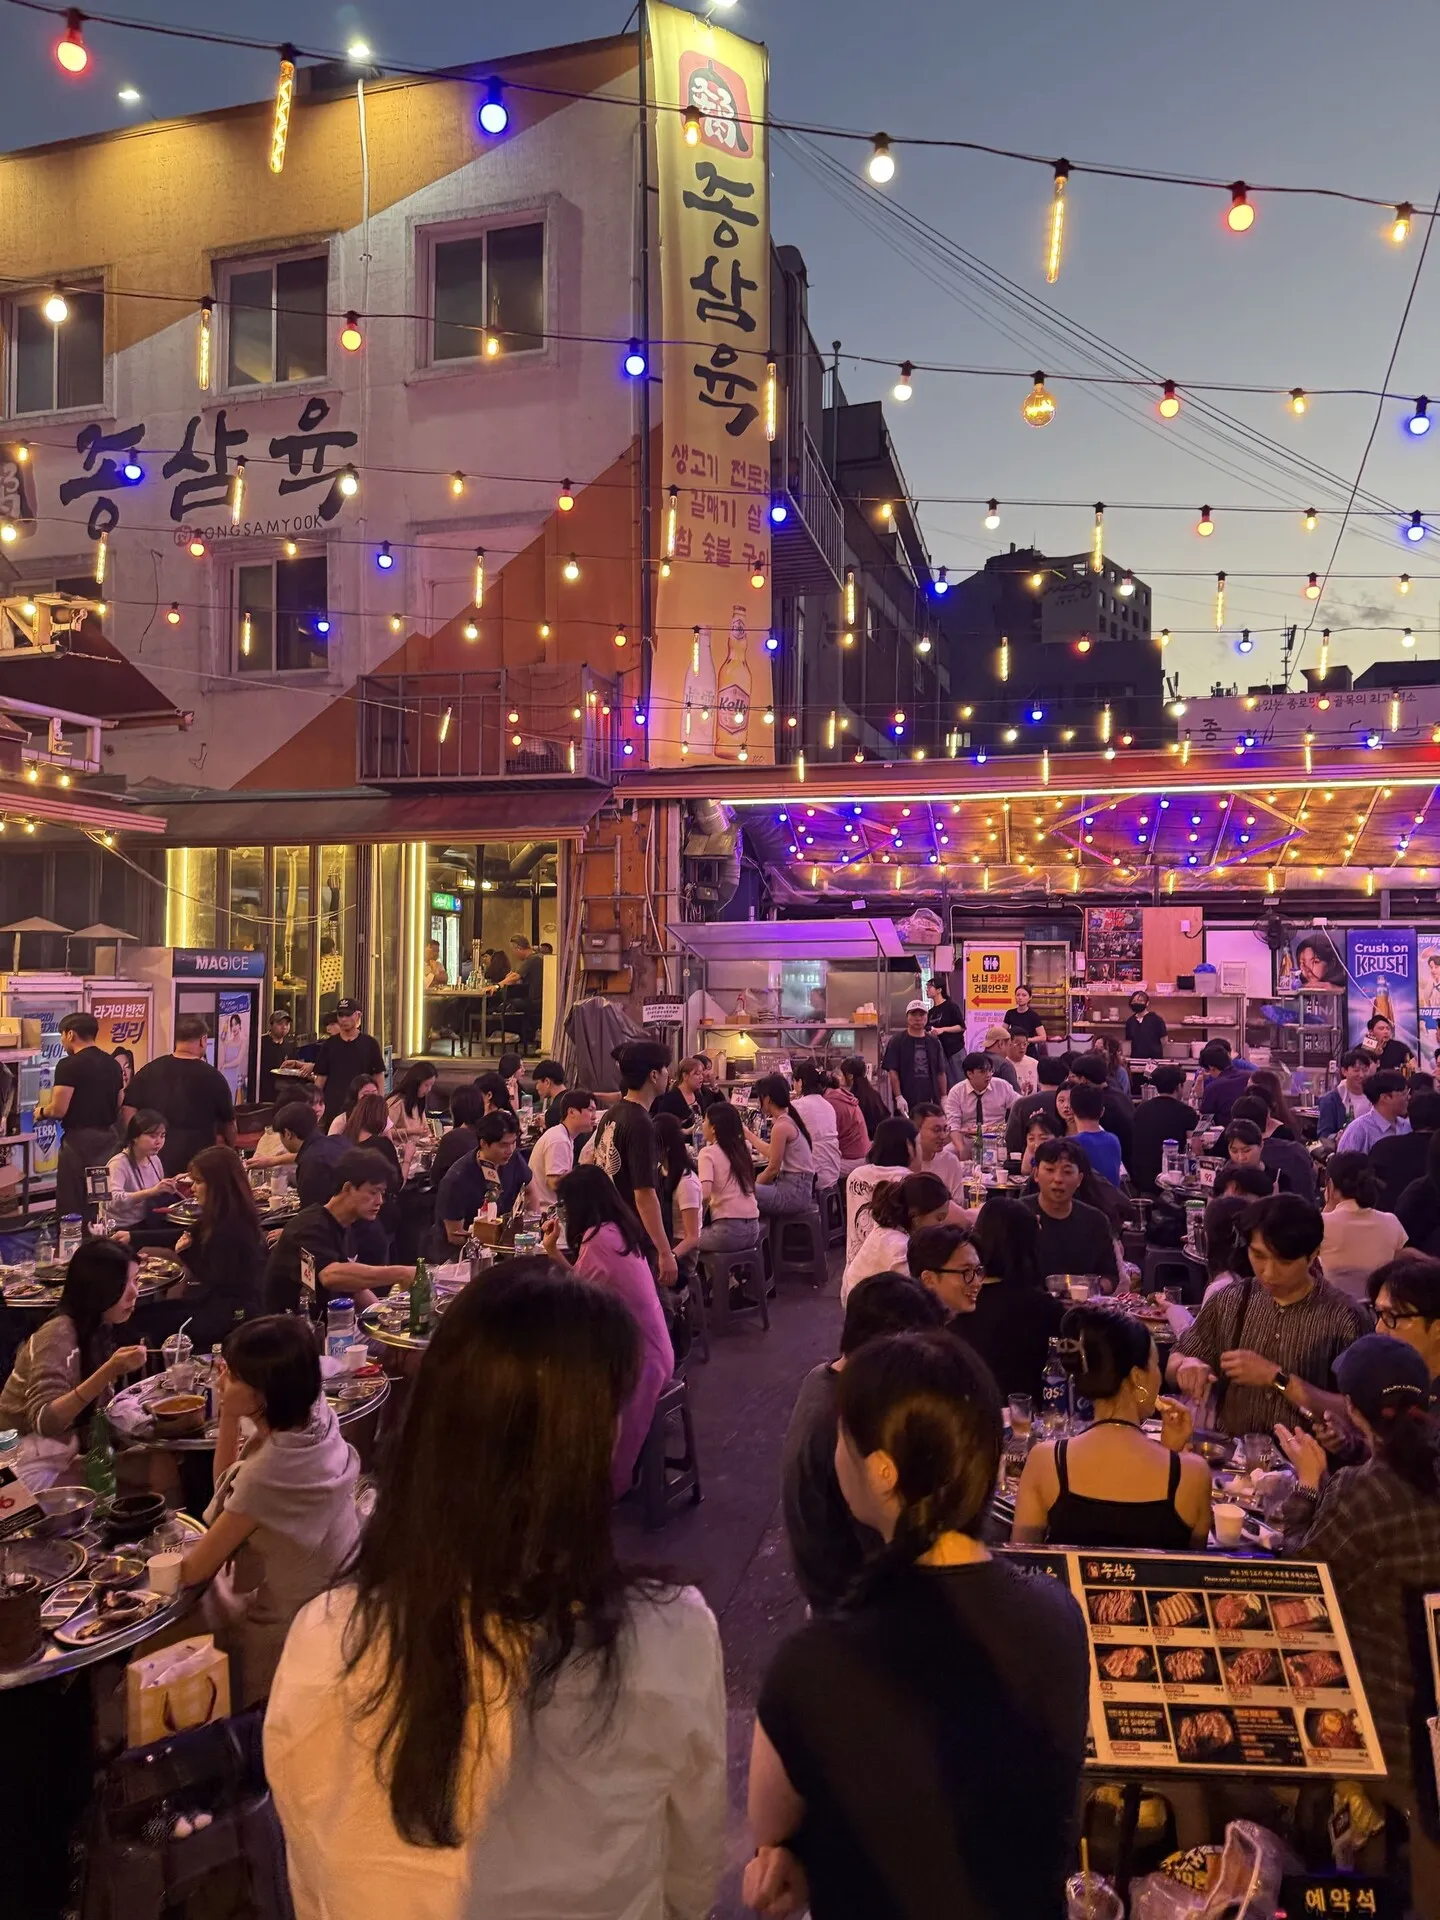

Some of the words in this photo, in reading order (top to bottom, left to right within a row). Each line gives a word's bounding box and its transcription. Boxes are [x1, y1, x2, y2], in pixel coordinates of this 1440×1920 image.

[683, 161, 759, 437] 종삼육
[60, 400, 362, 541] 종삼육
[672, 444, 718, 485] 생고기
[691, 489, 736, 528] 갈매기
[748, 504, 762, 534] 살
[203, 514, 324, 540] ONGSAMYOOK
[702, 532, 732, 567] 숯불
[719, 697, 748, 716] Kelly
[1355, 943, 1389, 953] Crush
[1393, 945, 1408, 953] on
[195, 955, 249, 971] MAGICE
[1355, 954, 1408, 978] KRUSH
[990, 973, 1011, 985] 화장실
[94, 1004, 125, 1018] 라거의
[125, 1003, 145, 1018] 반전
[111, 1021, 145, 1044] 켈리
[34, 1124, 56, 1138] TERRA
[1305, 1888, 1377, 1912] 예약석
